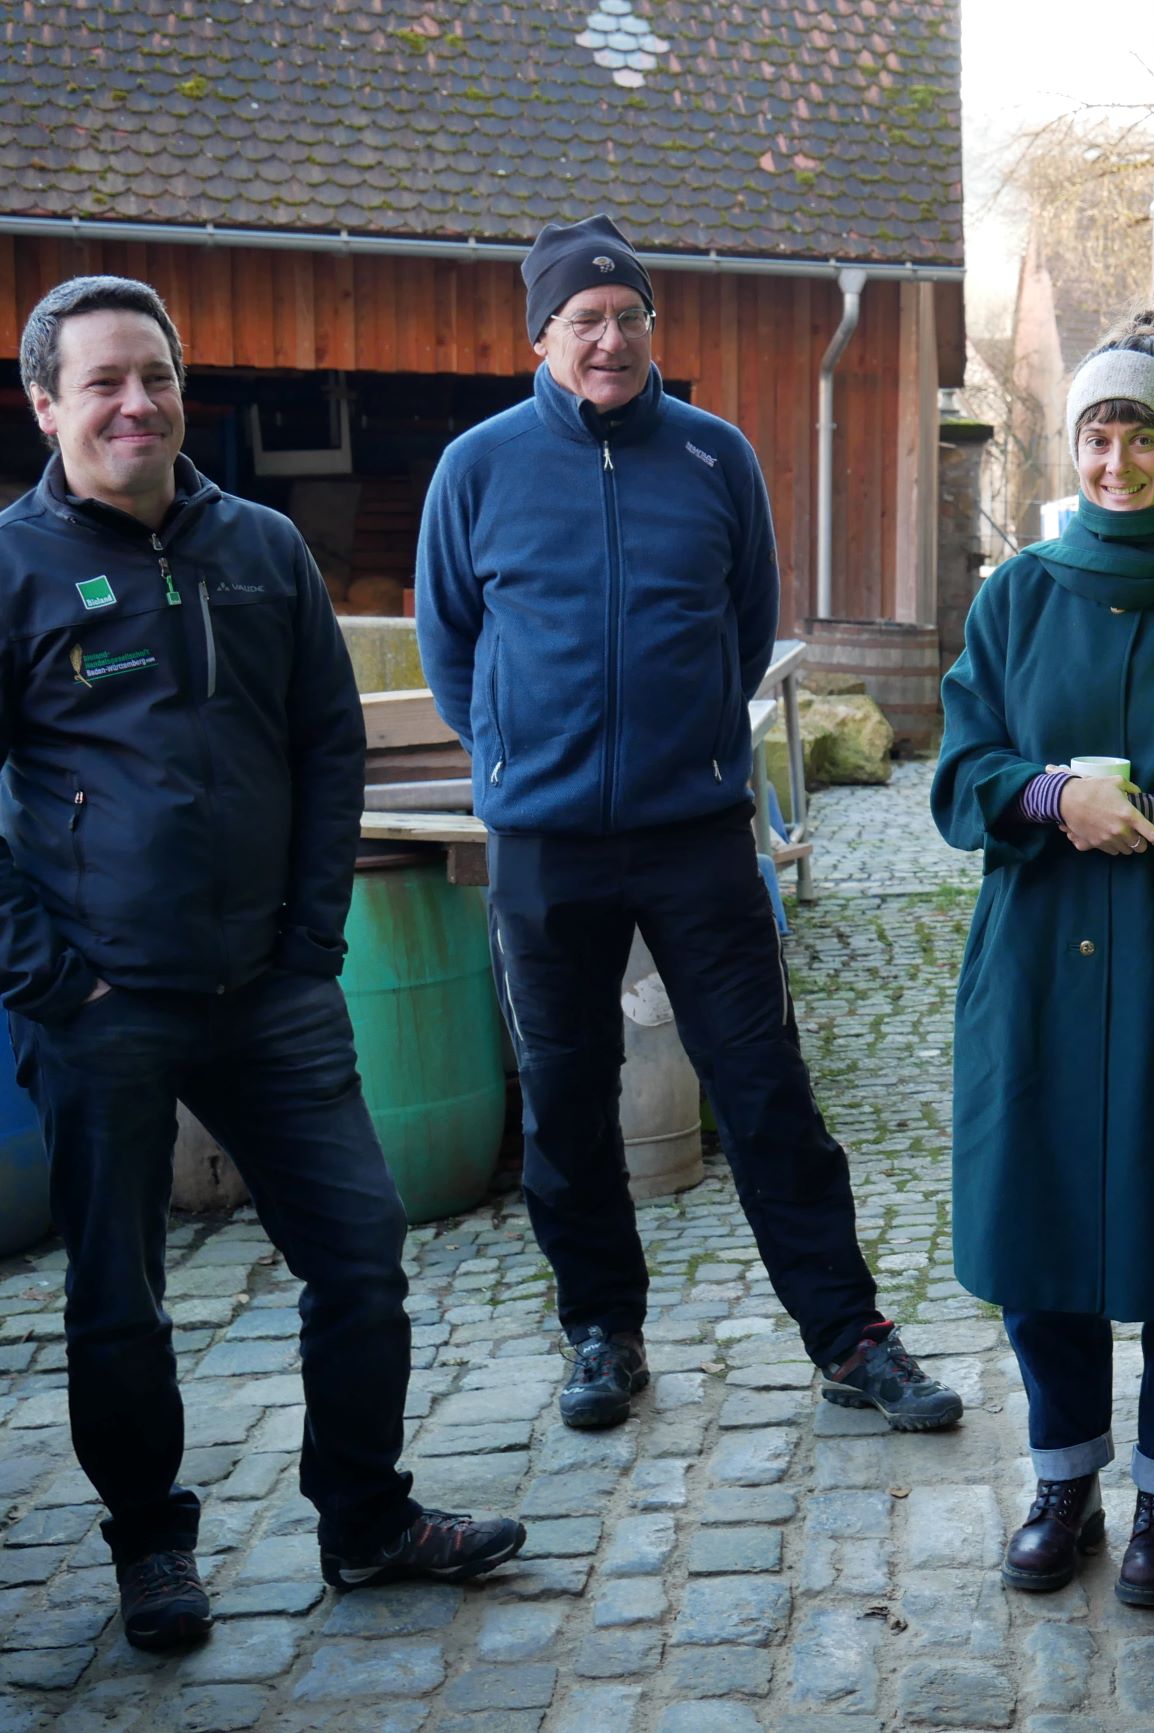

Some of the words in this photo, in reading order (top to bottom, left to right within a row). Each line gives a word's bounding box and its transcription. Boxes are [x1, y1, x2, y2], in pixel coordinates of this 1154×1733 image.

[231, 583, 265, 593] VAUDE
[86, 594, 113, 607] Bioland
[86, 658, 145, 677] Baden-Württemberg
